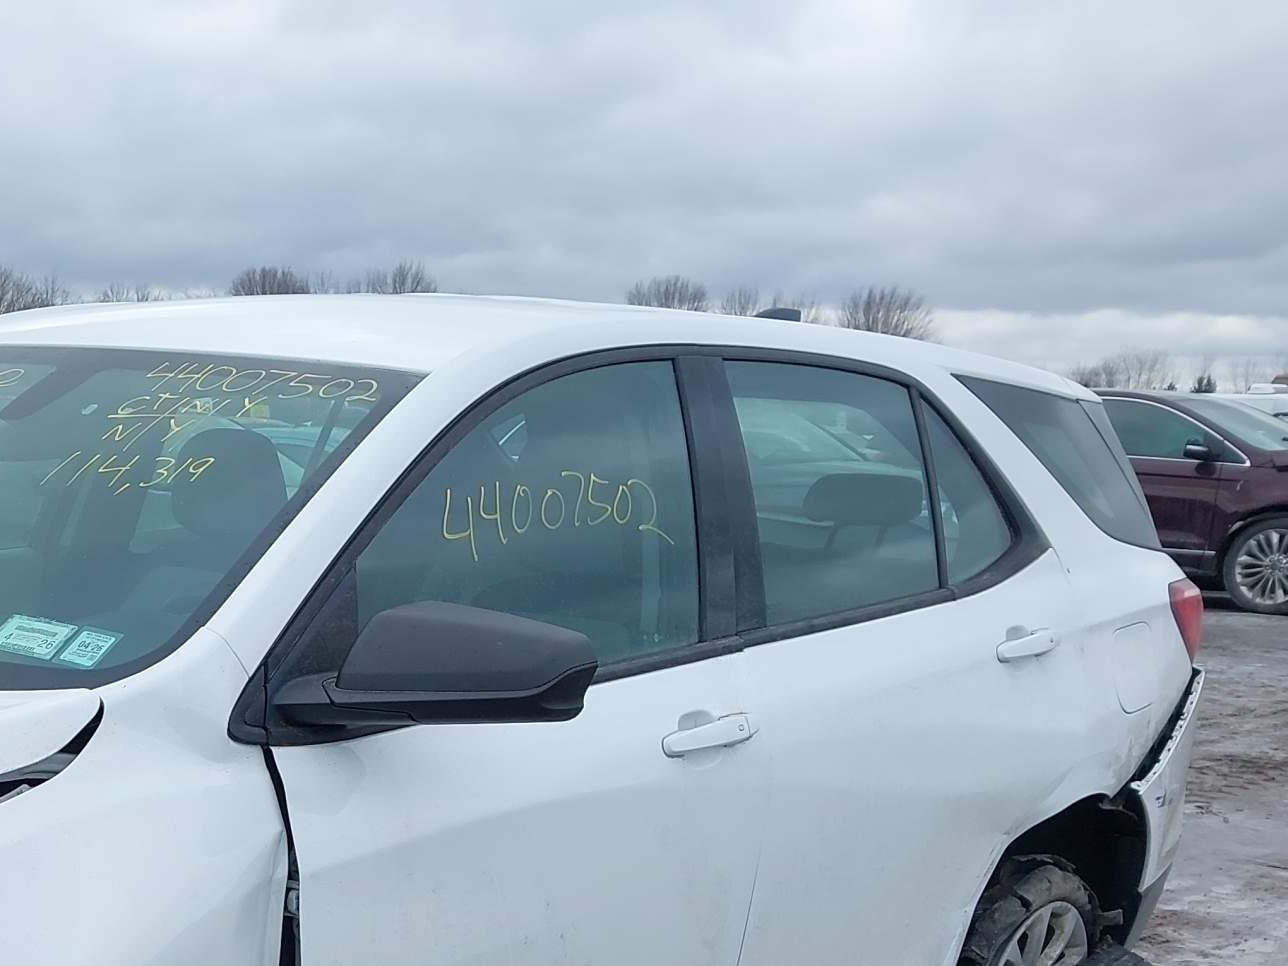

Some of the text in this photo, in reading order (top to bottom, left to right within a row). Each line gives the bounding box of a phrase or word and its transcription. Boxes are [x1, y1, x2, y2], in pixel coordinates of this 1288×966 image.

[146, 361, 378, 402] 44007502
[39, 450, 216, 496] 114,319
[443, 470, 675, 562] 44007502
